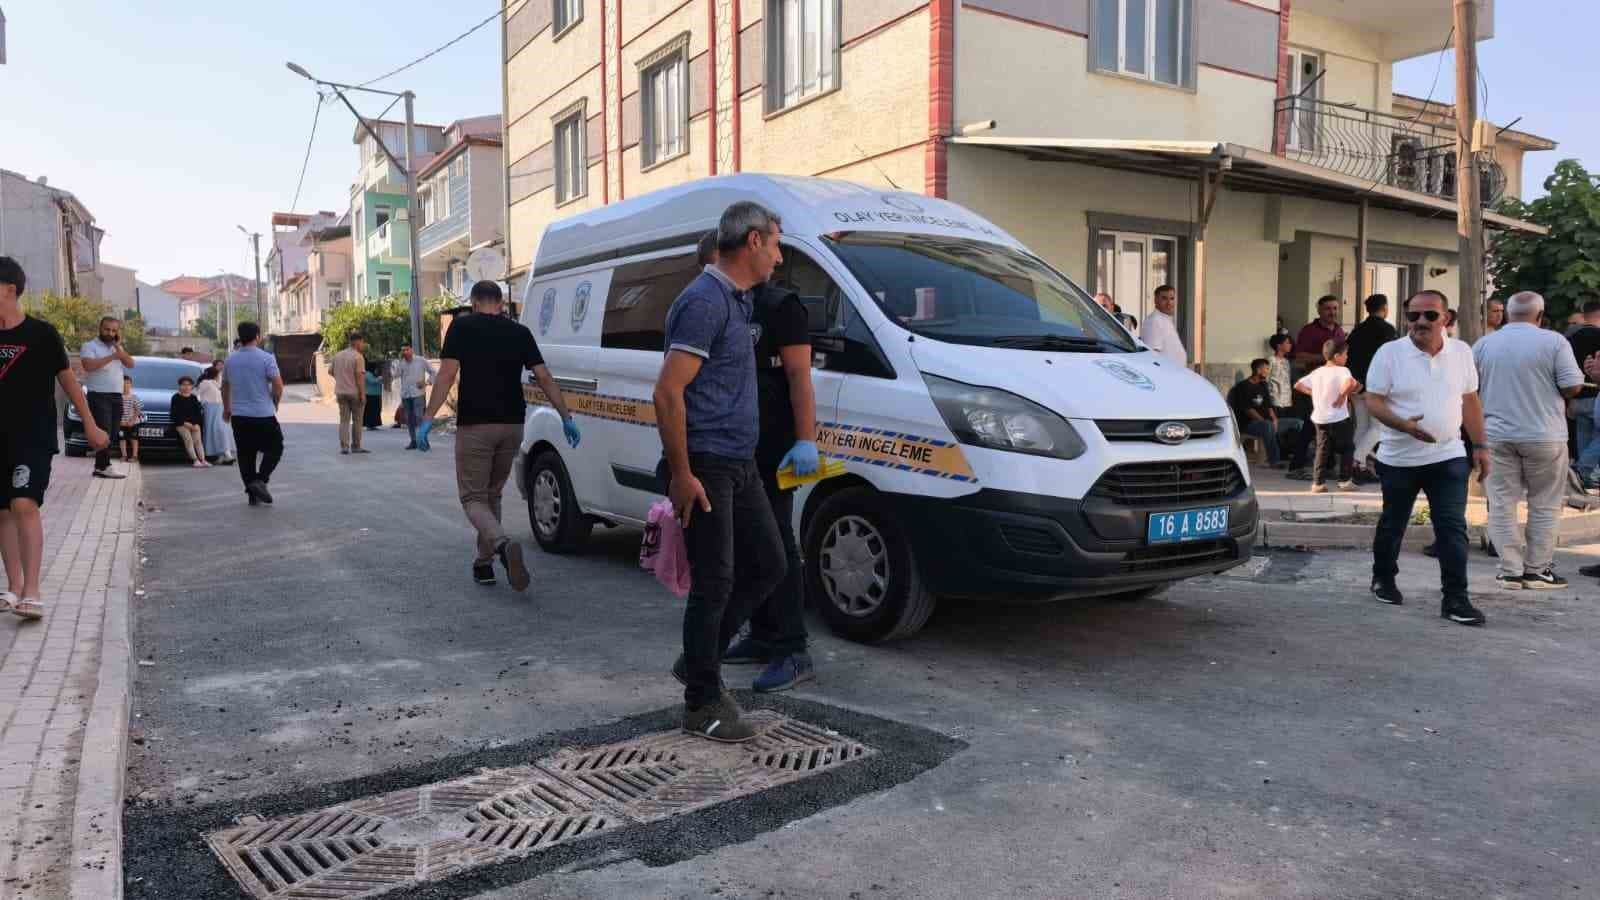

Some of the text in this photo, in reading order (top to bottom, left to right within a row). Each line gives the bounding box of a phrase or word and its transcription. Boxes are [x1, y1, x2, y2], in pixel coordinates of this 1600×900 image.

[833, 211, 873, 223] OLAY
[816, 431, 933, 463] AY YERİ İNCELEME
[1160, 510, 1226, 536] 16 A 8583
